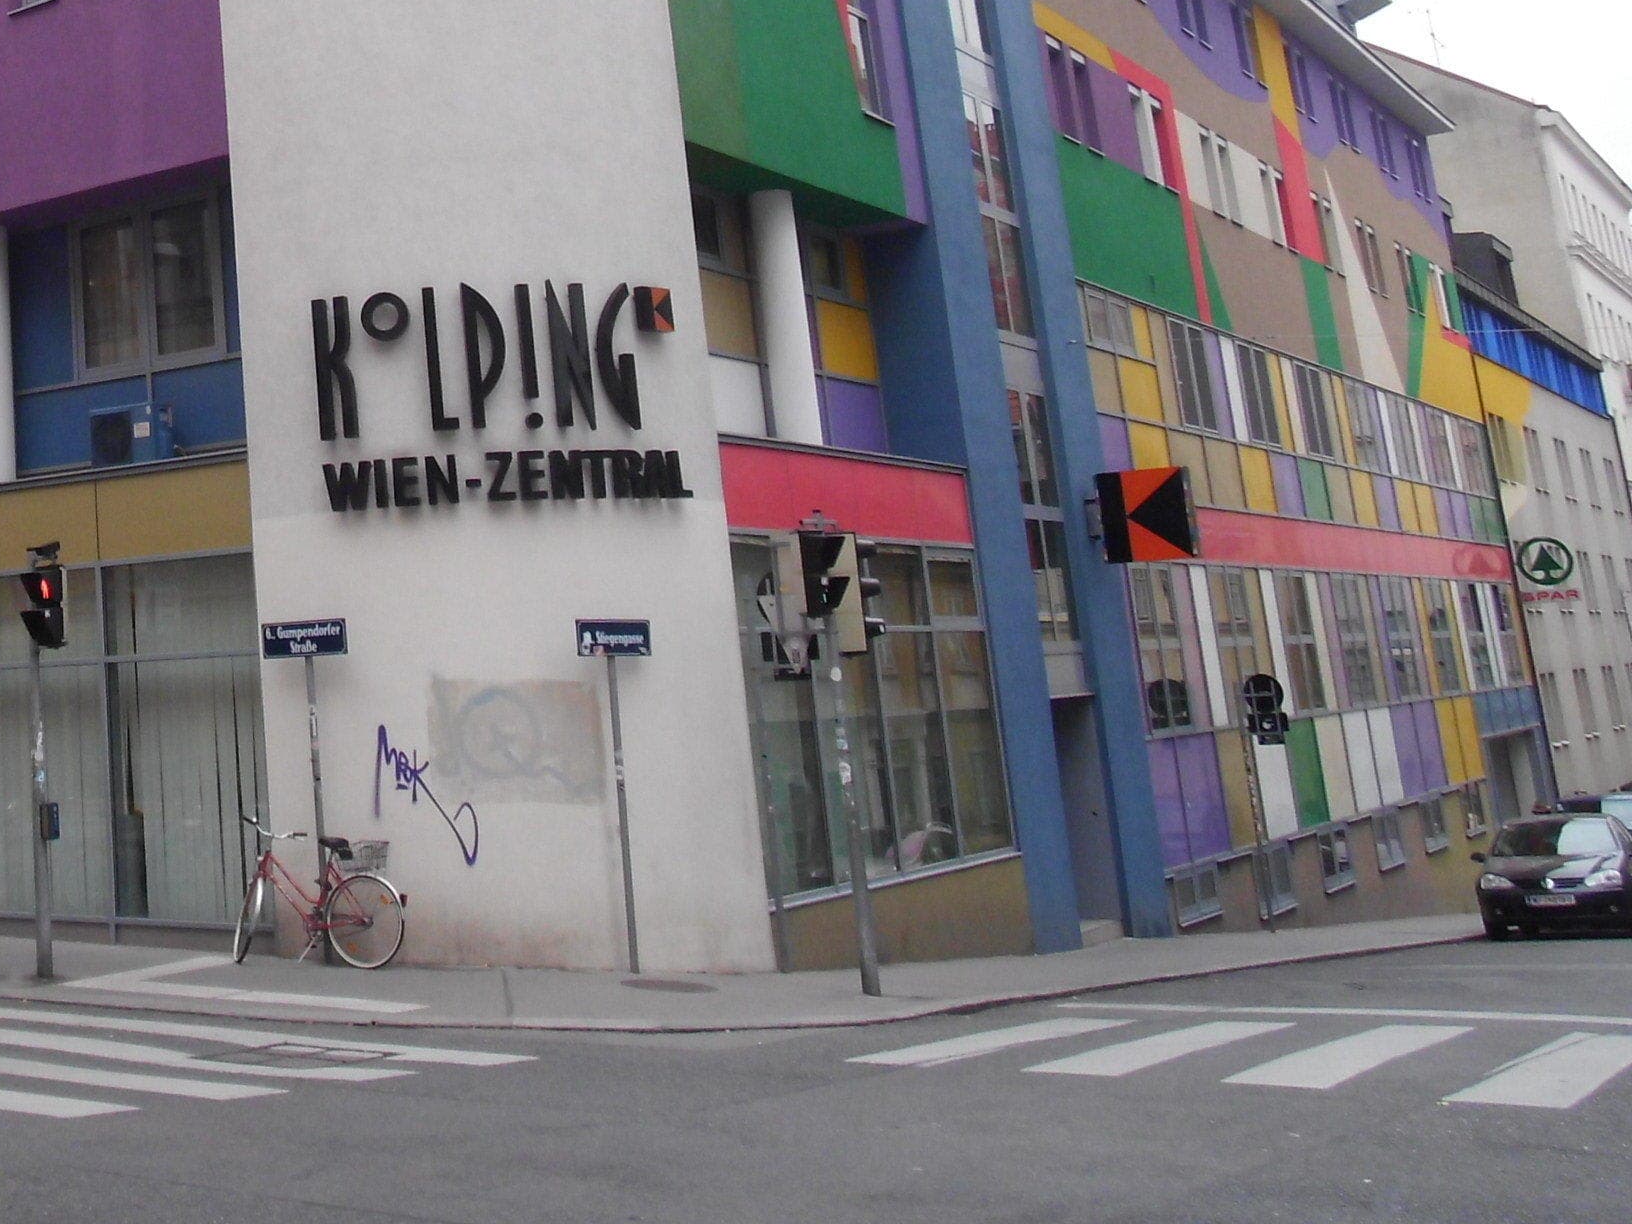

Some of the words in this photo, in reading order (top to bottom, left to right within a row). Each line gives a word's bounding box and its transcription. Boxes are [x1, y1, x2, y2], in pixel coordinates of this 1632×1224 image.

[322, 449, 694, 513] WIEN-ZENTRAL
[1522, 589, 1579, 602] SPAR
[277, 623, 341, 641] Gumpendorfer
[290, 639, 318, 654] Straße
